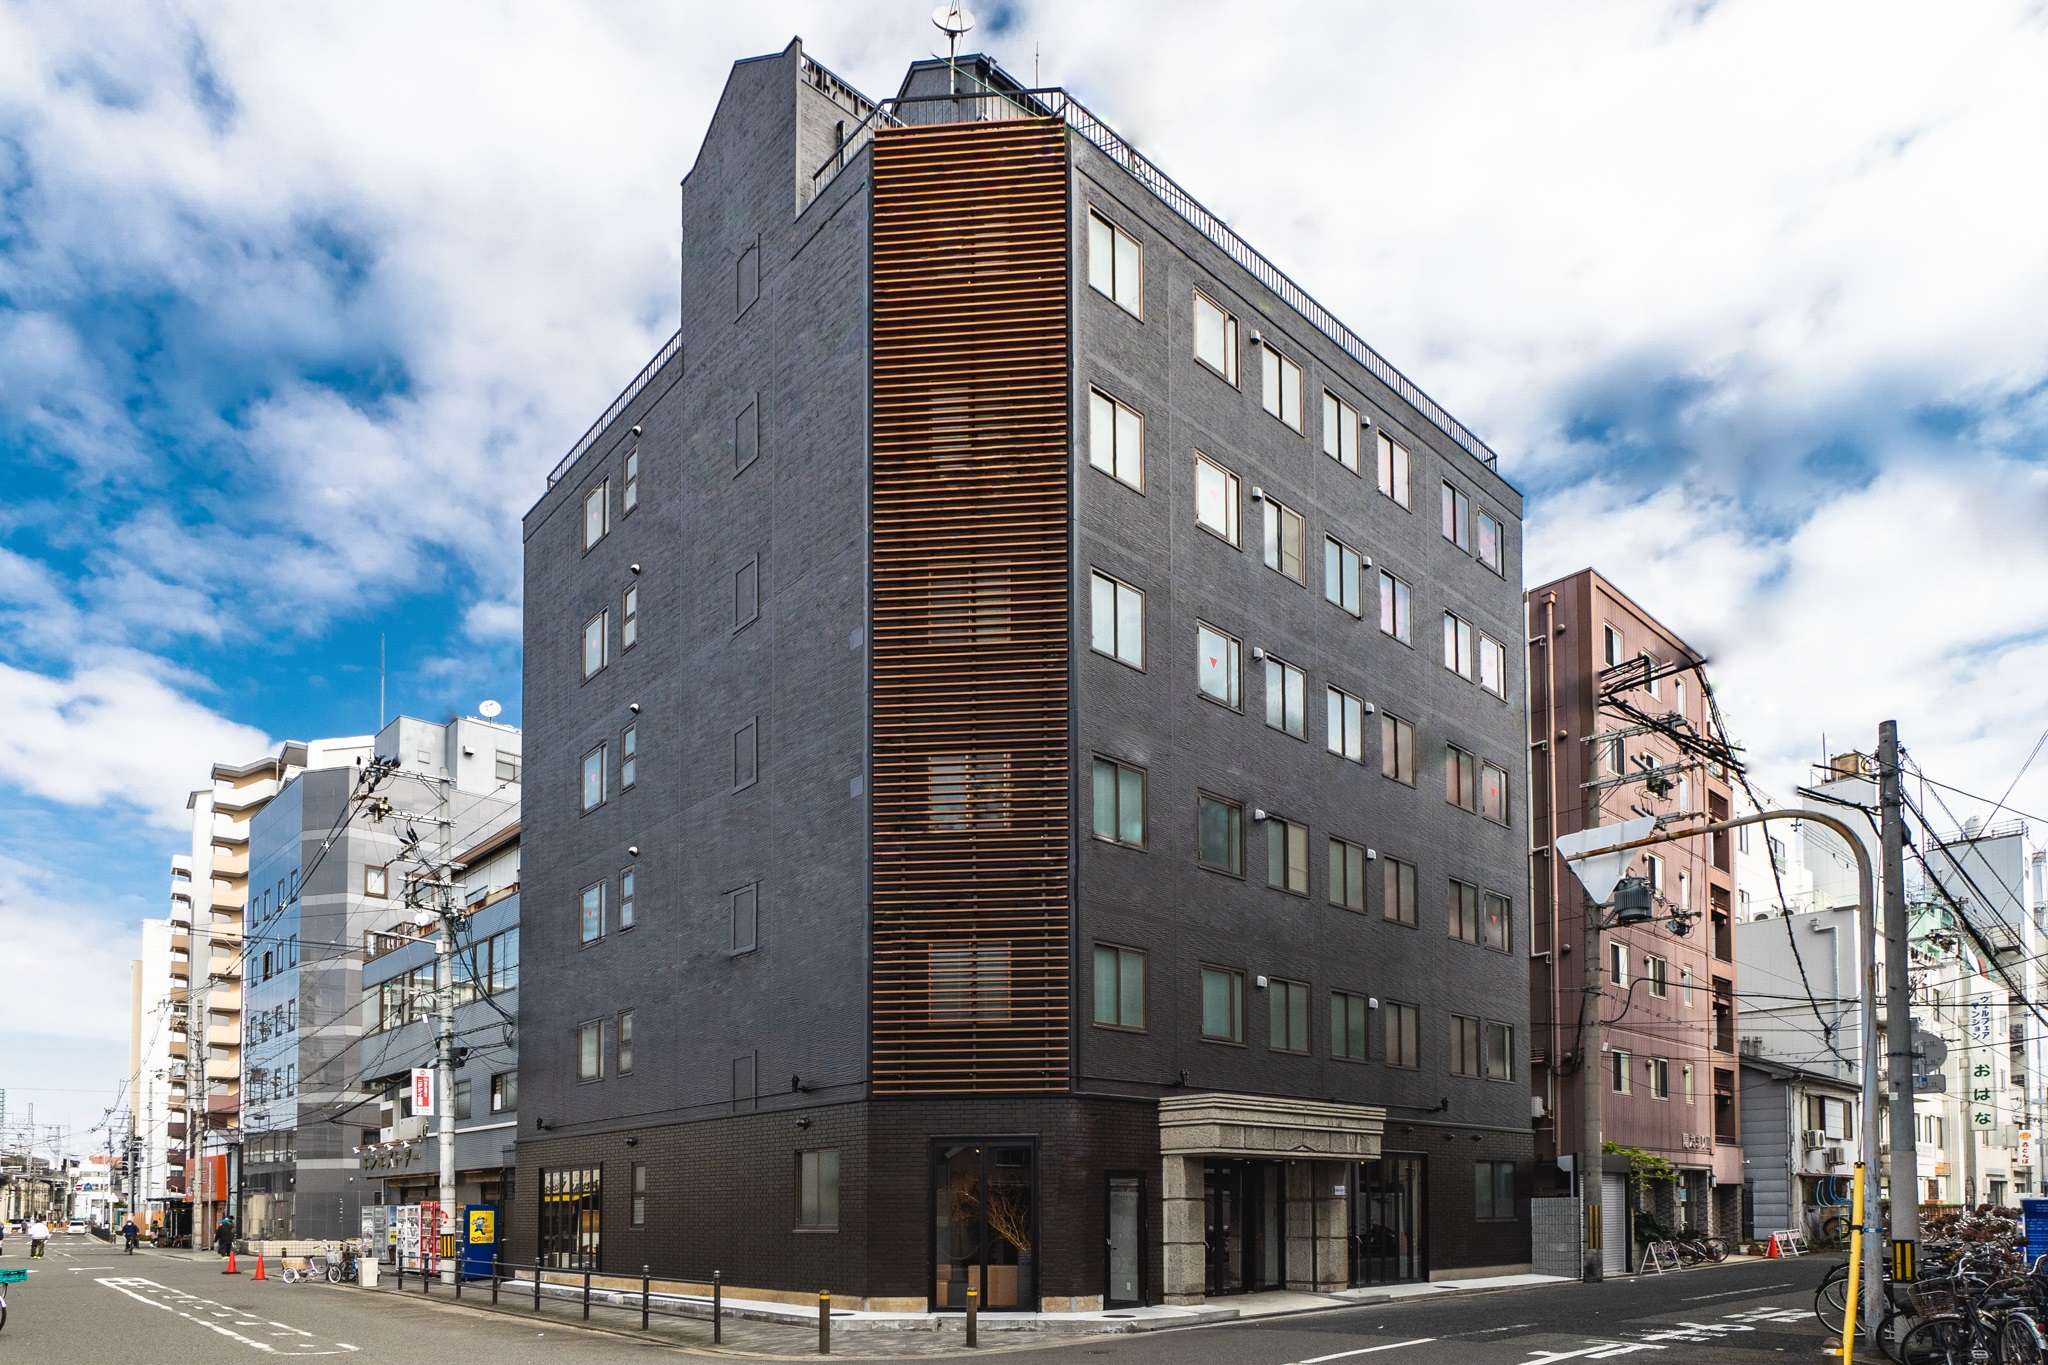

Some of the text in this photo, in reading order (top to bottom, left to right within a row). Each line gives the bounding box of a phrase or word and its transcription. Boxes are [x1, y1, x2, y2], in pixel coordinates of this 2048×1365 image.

[1971, 1002, 1981, 1041] マンション
